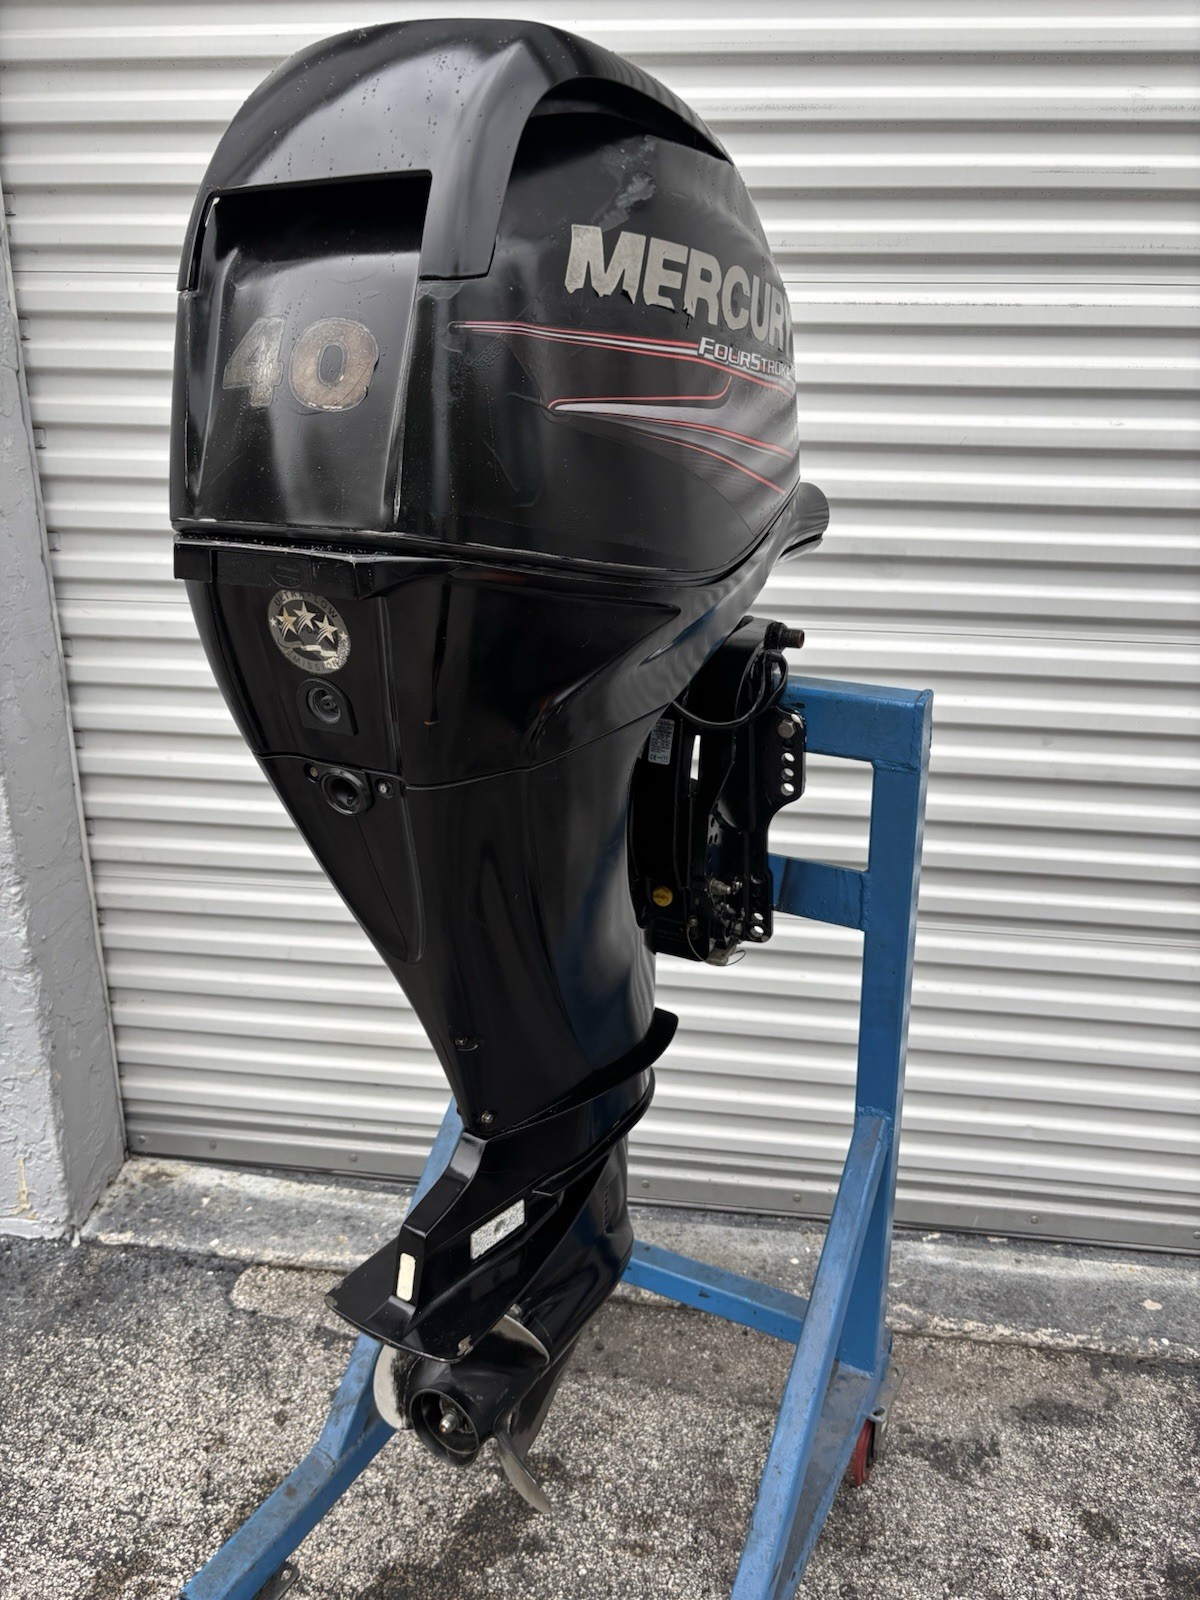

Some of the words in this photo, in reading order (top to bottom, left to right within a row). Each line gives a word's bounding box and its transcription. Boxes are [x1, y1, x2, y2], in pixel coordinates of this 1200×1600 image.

[564, 224, 793, 355] MERCURY
[222, 316, 379, 412] 40
[314, 594, 338, 618] LOW
